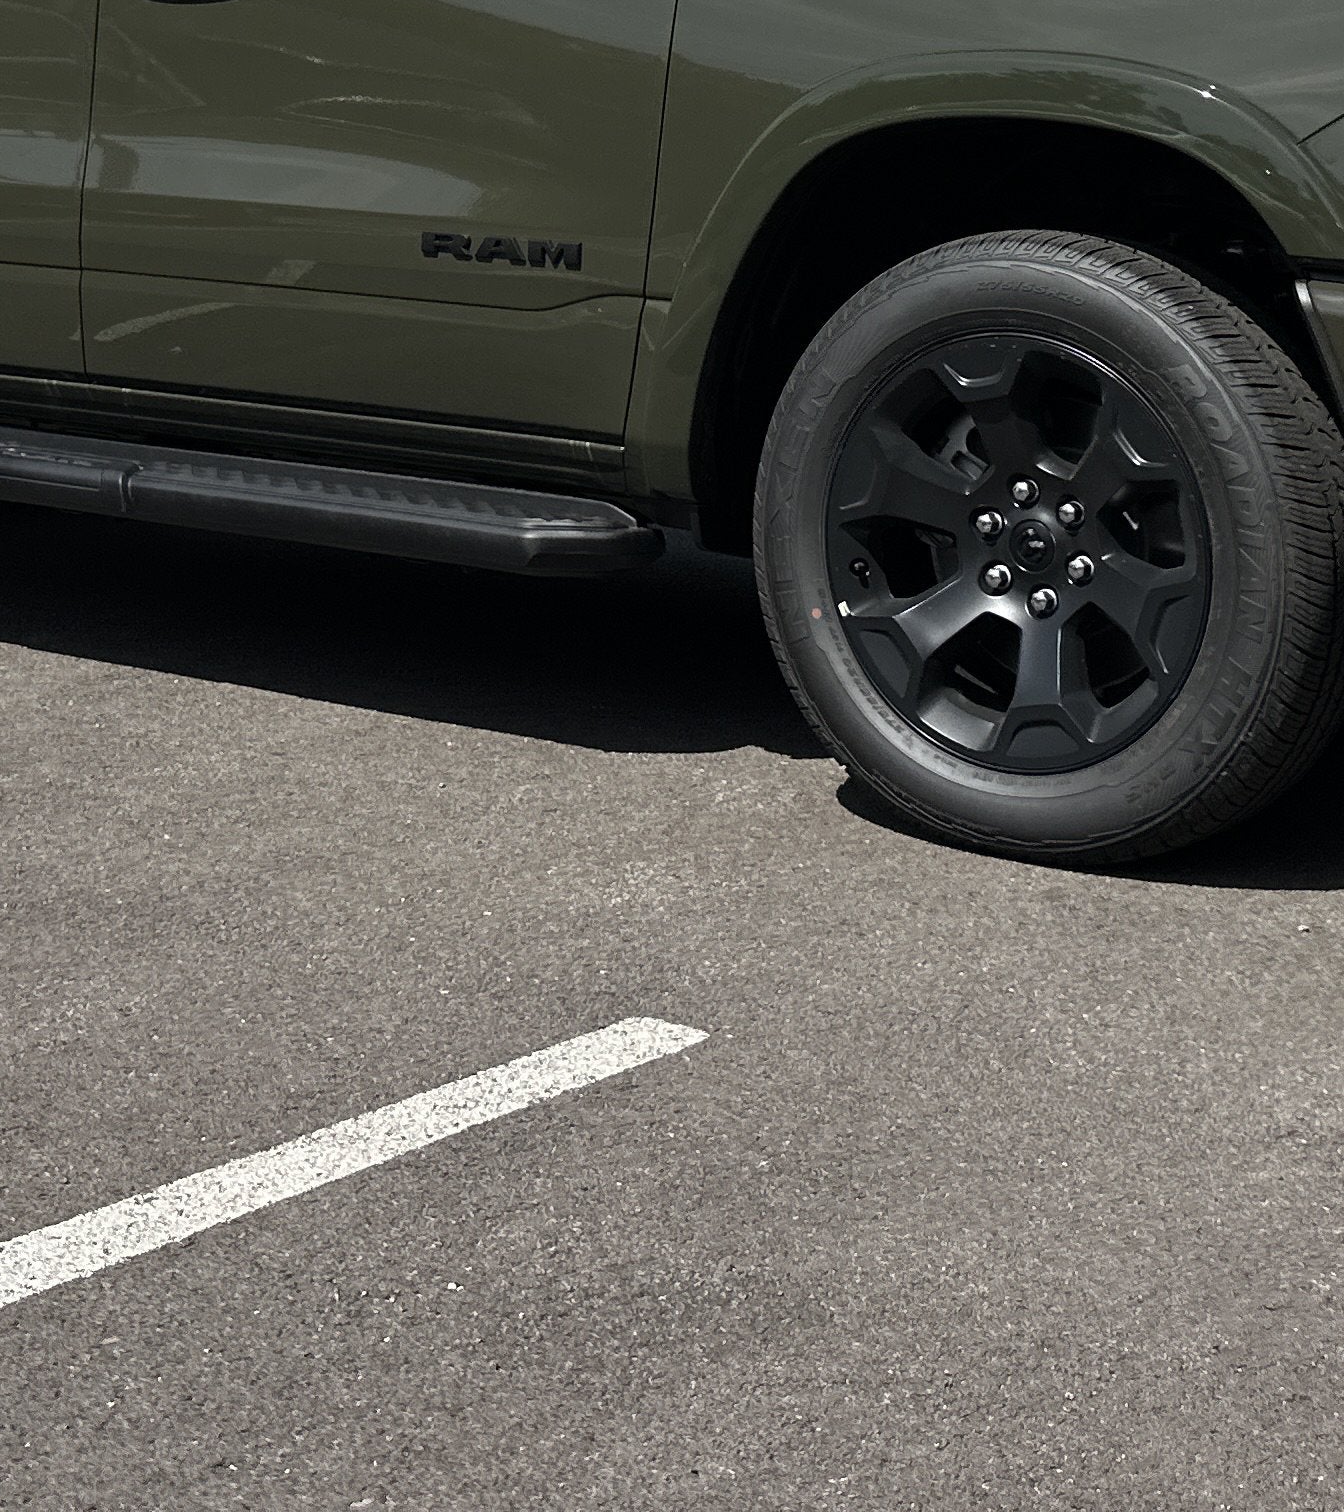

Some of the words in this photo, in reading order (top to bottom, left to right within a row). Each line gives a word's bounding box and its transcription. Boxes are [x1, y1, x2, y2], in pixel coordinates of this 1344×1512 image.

[420, 231, 583, 271] RAM
[766, 370, 835, 641] NEXEN
[1168, 364, 1267, 642] ROADIAN
